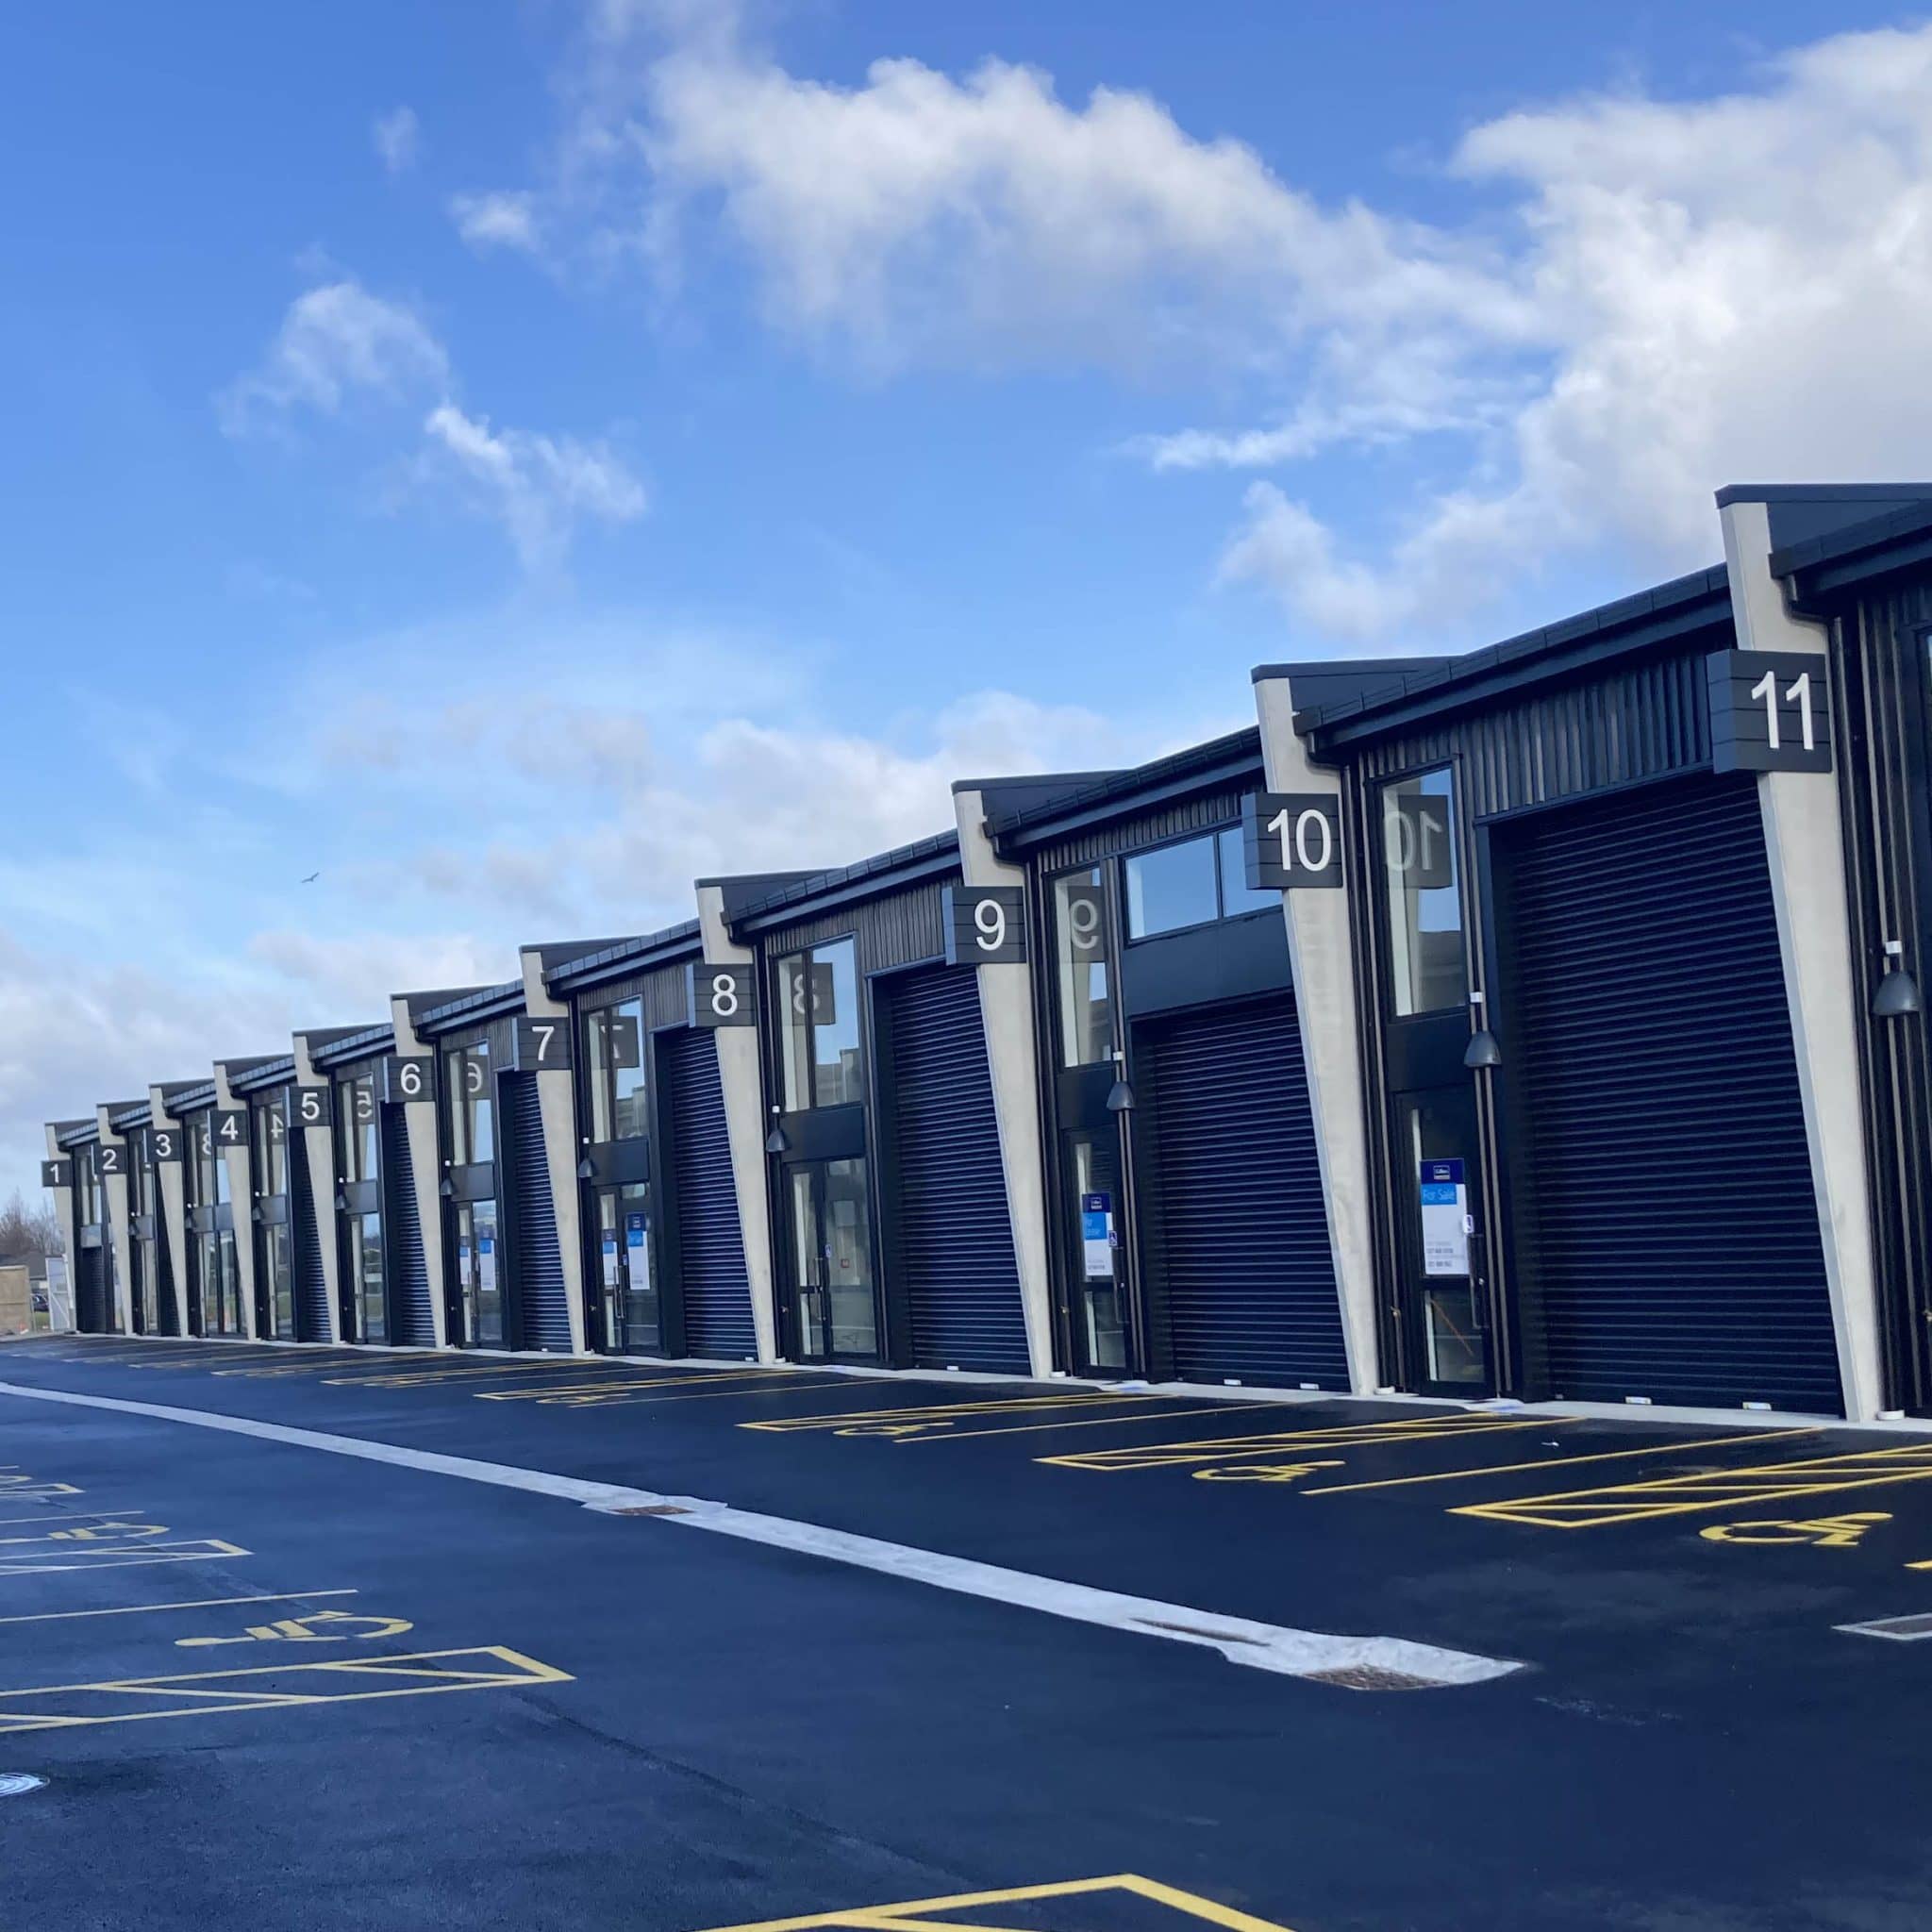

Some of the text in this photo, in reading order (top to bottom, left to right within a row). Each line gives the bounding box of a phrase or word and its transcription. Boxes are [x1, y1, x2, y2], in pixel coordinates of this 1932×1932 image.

[1751, 671, 1814, 751] 11
[1267, 808, 1332, 872] 10
[974, 899, 1006, 951] 9
[711, 974, 738, 1017] 8
[531, 1025, 555, 1061] 7
[400, 1062, 422, 1095] 6
[301, 1091, 320, 1121] 5
[220, 1114, 239, 1141] 4
[102, 1148, 118, 1171] 2
[156, 1134, 172, 1158] 3
[50, 1163, 60, 1183] 1
